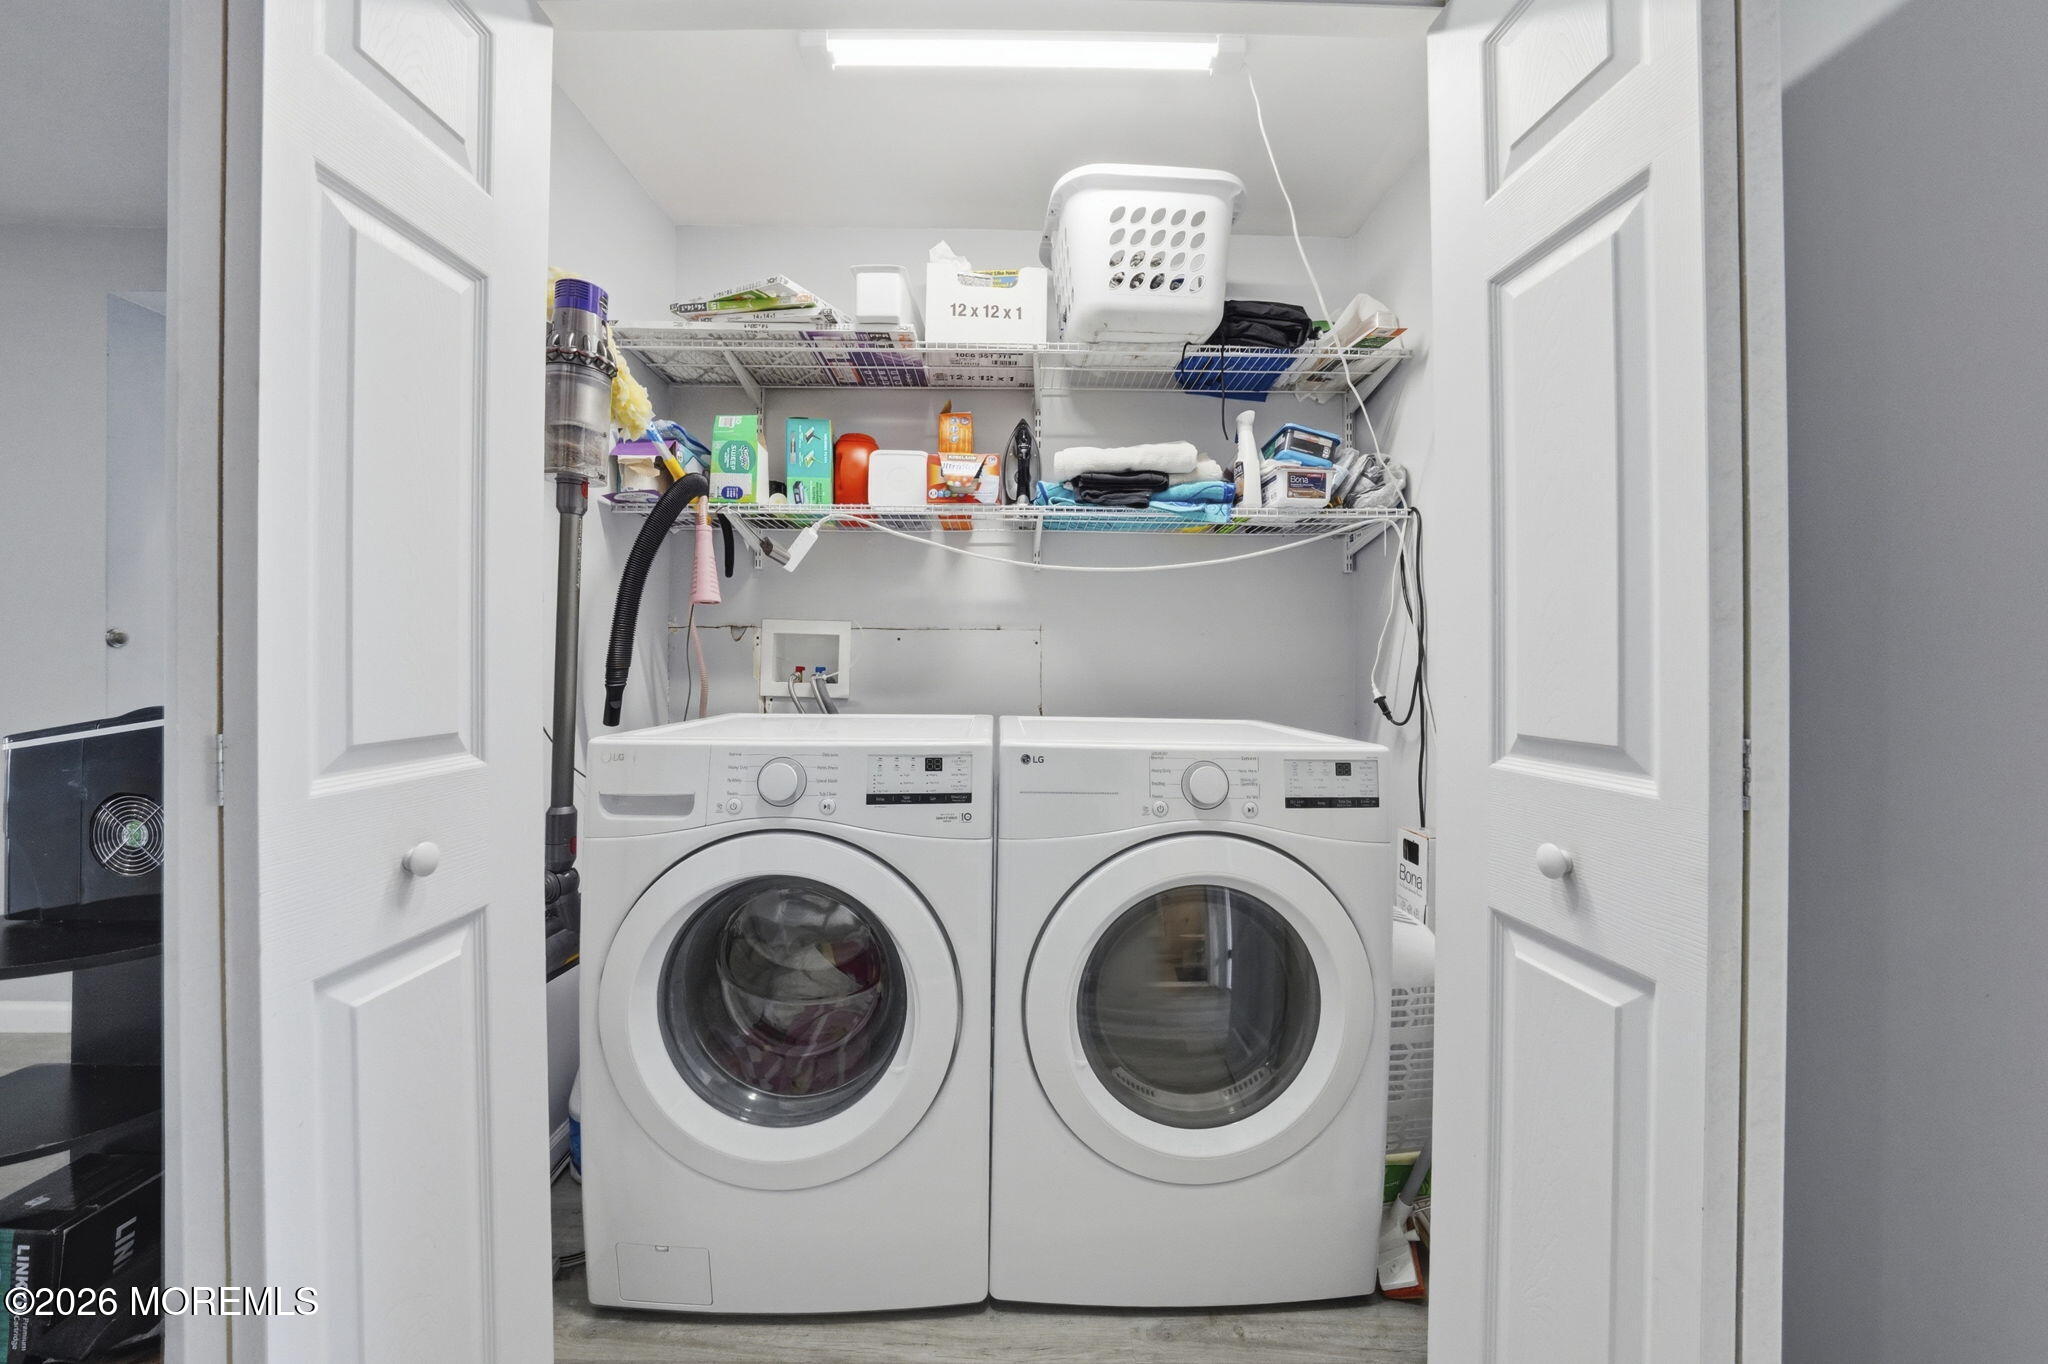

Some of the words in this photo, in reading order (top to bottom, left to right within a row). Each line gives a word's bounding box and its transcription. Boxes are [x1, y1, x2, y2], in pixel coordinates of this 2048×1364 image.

[950, 303, 967, 317] 12
[970, 307, 979, 317] x
[983, 304, 999, 319] 12
[1003, 308, 1012, 320] x
[1016, 306, 1022, 320] 1
[1290, 475, 1309, 484] Bona
[1032, 755, 1045, 764] LG
[1399, 863, 1423, 891] Bona
[10, 1315, 20, 1350] Cartridge
